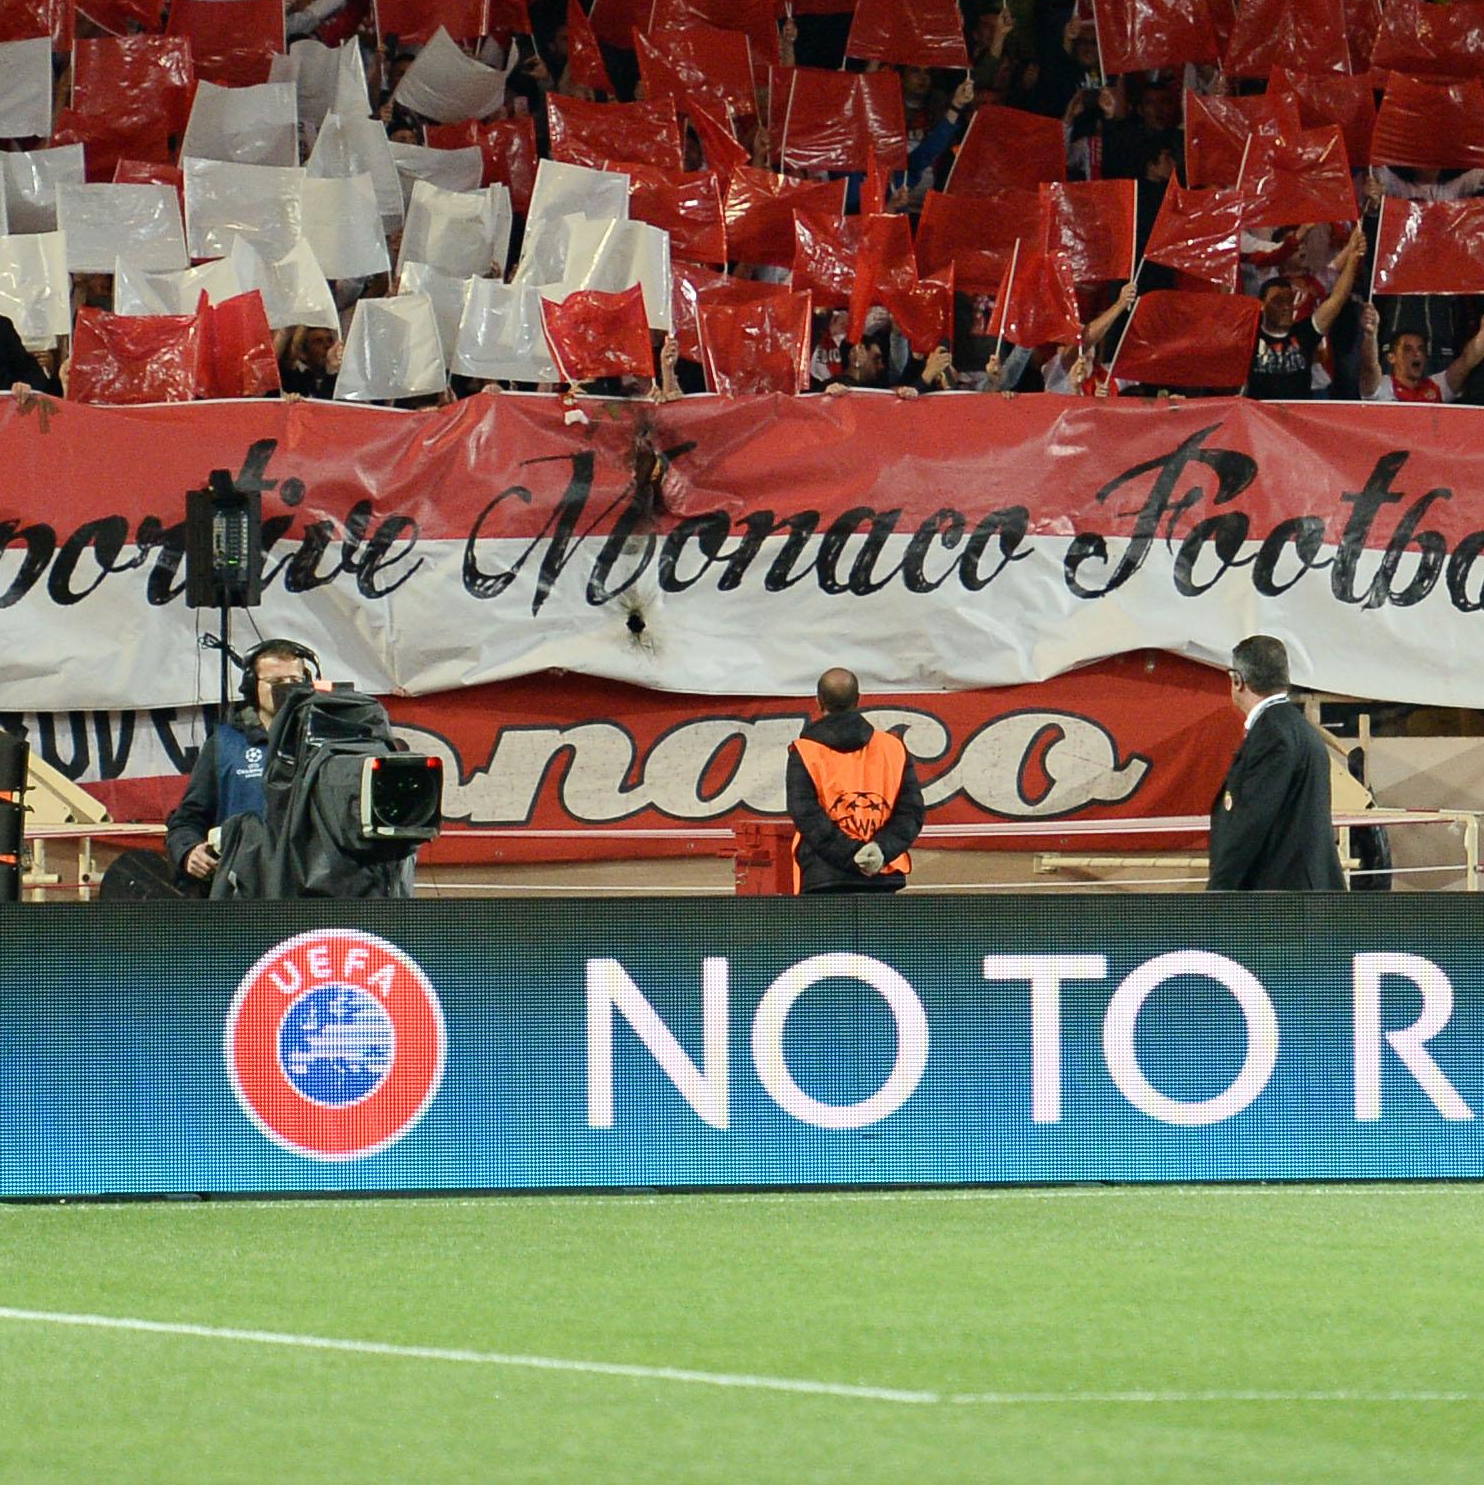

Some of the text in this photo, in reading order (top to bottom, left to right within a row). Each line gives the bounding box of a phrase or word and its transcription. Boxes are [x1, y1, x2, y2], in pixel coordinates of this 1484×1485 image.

[463, 440, 1036, 617] Monaco
[268, 945, 396, 997] UEFA
[584, 951, 930, 1130] NO
[982, 949, 1280, 1126] TO
